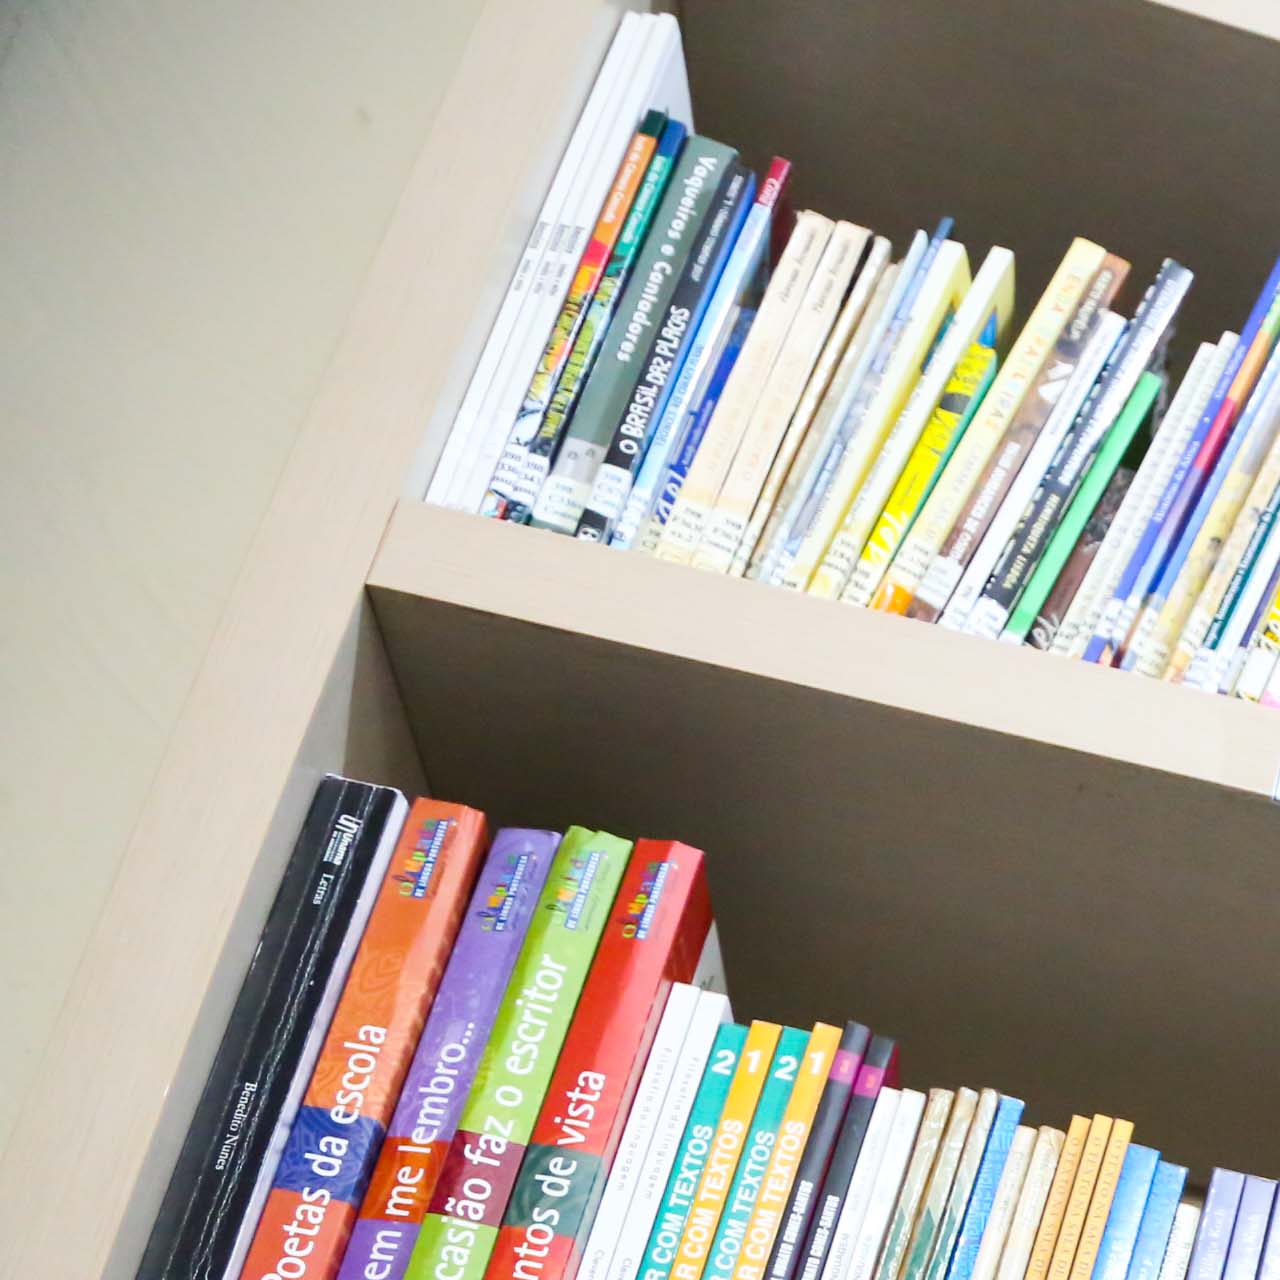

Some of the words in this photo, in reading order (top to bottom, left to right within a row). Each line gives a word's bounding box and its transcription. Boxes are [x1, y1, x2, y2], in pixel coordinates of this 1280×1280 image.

[668, 156, 718, 242] Vaqueiros
[617, 262, 672, 362] Cantadores
[506, 954, 566, 1075] escritor
[398, 1022, 474, 1153] lembro...
[712, 1049, 736, 1075] 2
[746, 1050, 760, 1073] 1
[229, 1081, 258, 1137] Benedito
[304, 1140, 348, 1177] da
[331, 1025, 387, 1124] escola
[496, 1085, 522, 1106] o
[554, 1072, 605, 1144] vista
[215, 1132, 241, 1171] Nunes
[464, 1120, 514, 1165] faz
[385, 1166, 423, 1216] me
[535, 1157, 576, 1197] de
[651, 1207, 684, 1266] COM
[669, 1125, 713, 1210] TEXTOS
